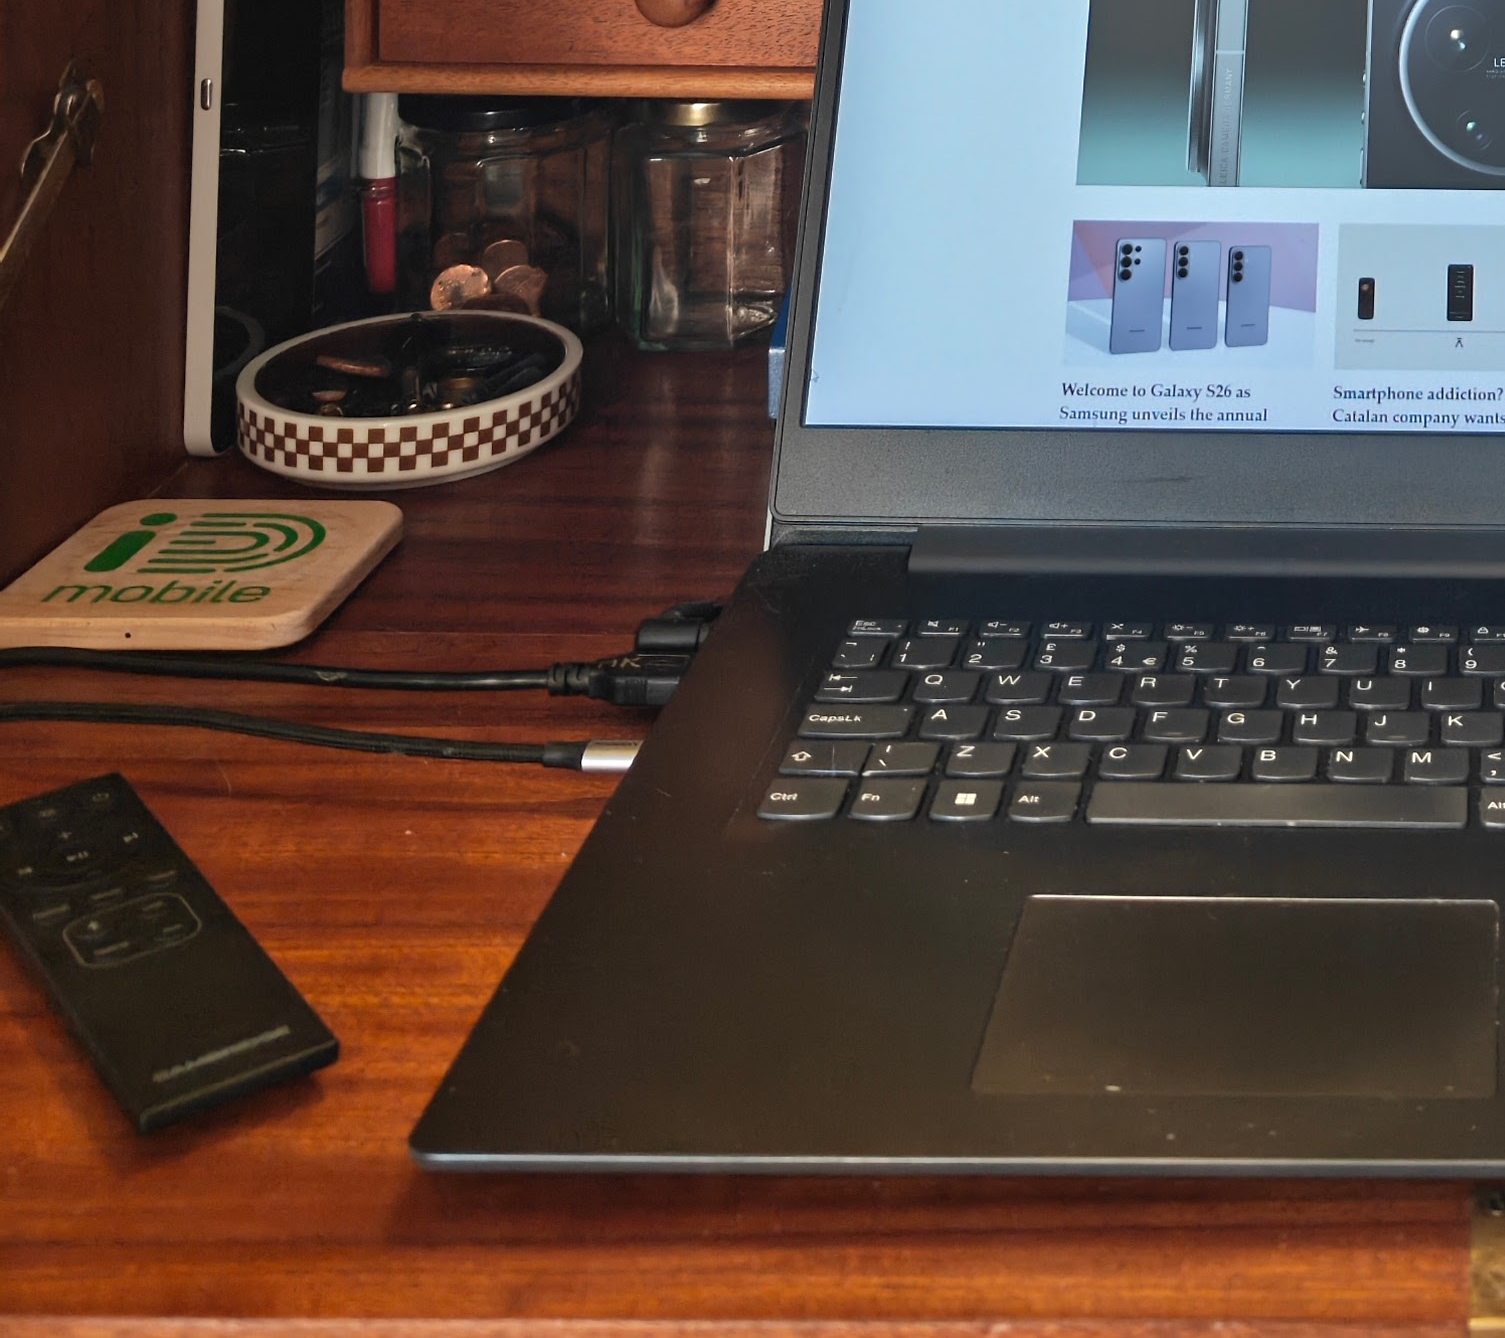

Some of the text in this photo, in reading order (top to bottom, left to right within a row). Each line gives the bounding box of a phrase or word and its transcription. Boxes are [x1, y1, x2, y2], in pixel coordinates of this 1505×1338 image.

[1063, 383, 1250, 401] Welcome to Galaxy S26 as
[1334, 386, 1422, 404] Smartphone
[1428, 387, 1503, 400] addiction?
[1060, 407, 1267, 424] Samsung unveils the annual
[1333, 410, 1387, 422] Catalan
[1393, 414, 1459, 428] company
[1465, 413, 1505, 424] wants
[41, 579, 271, 604] mobile
[809, 713, 861, 722] CapsLk
[1018, 795, 1040, 803] Alt
